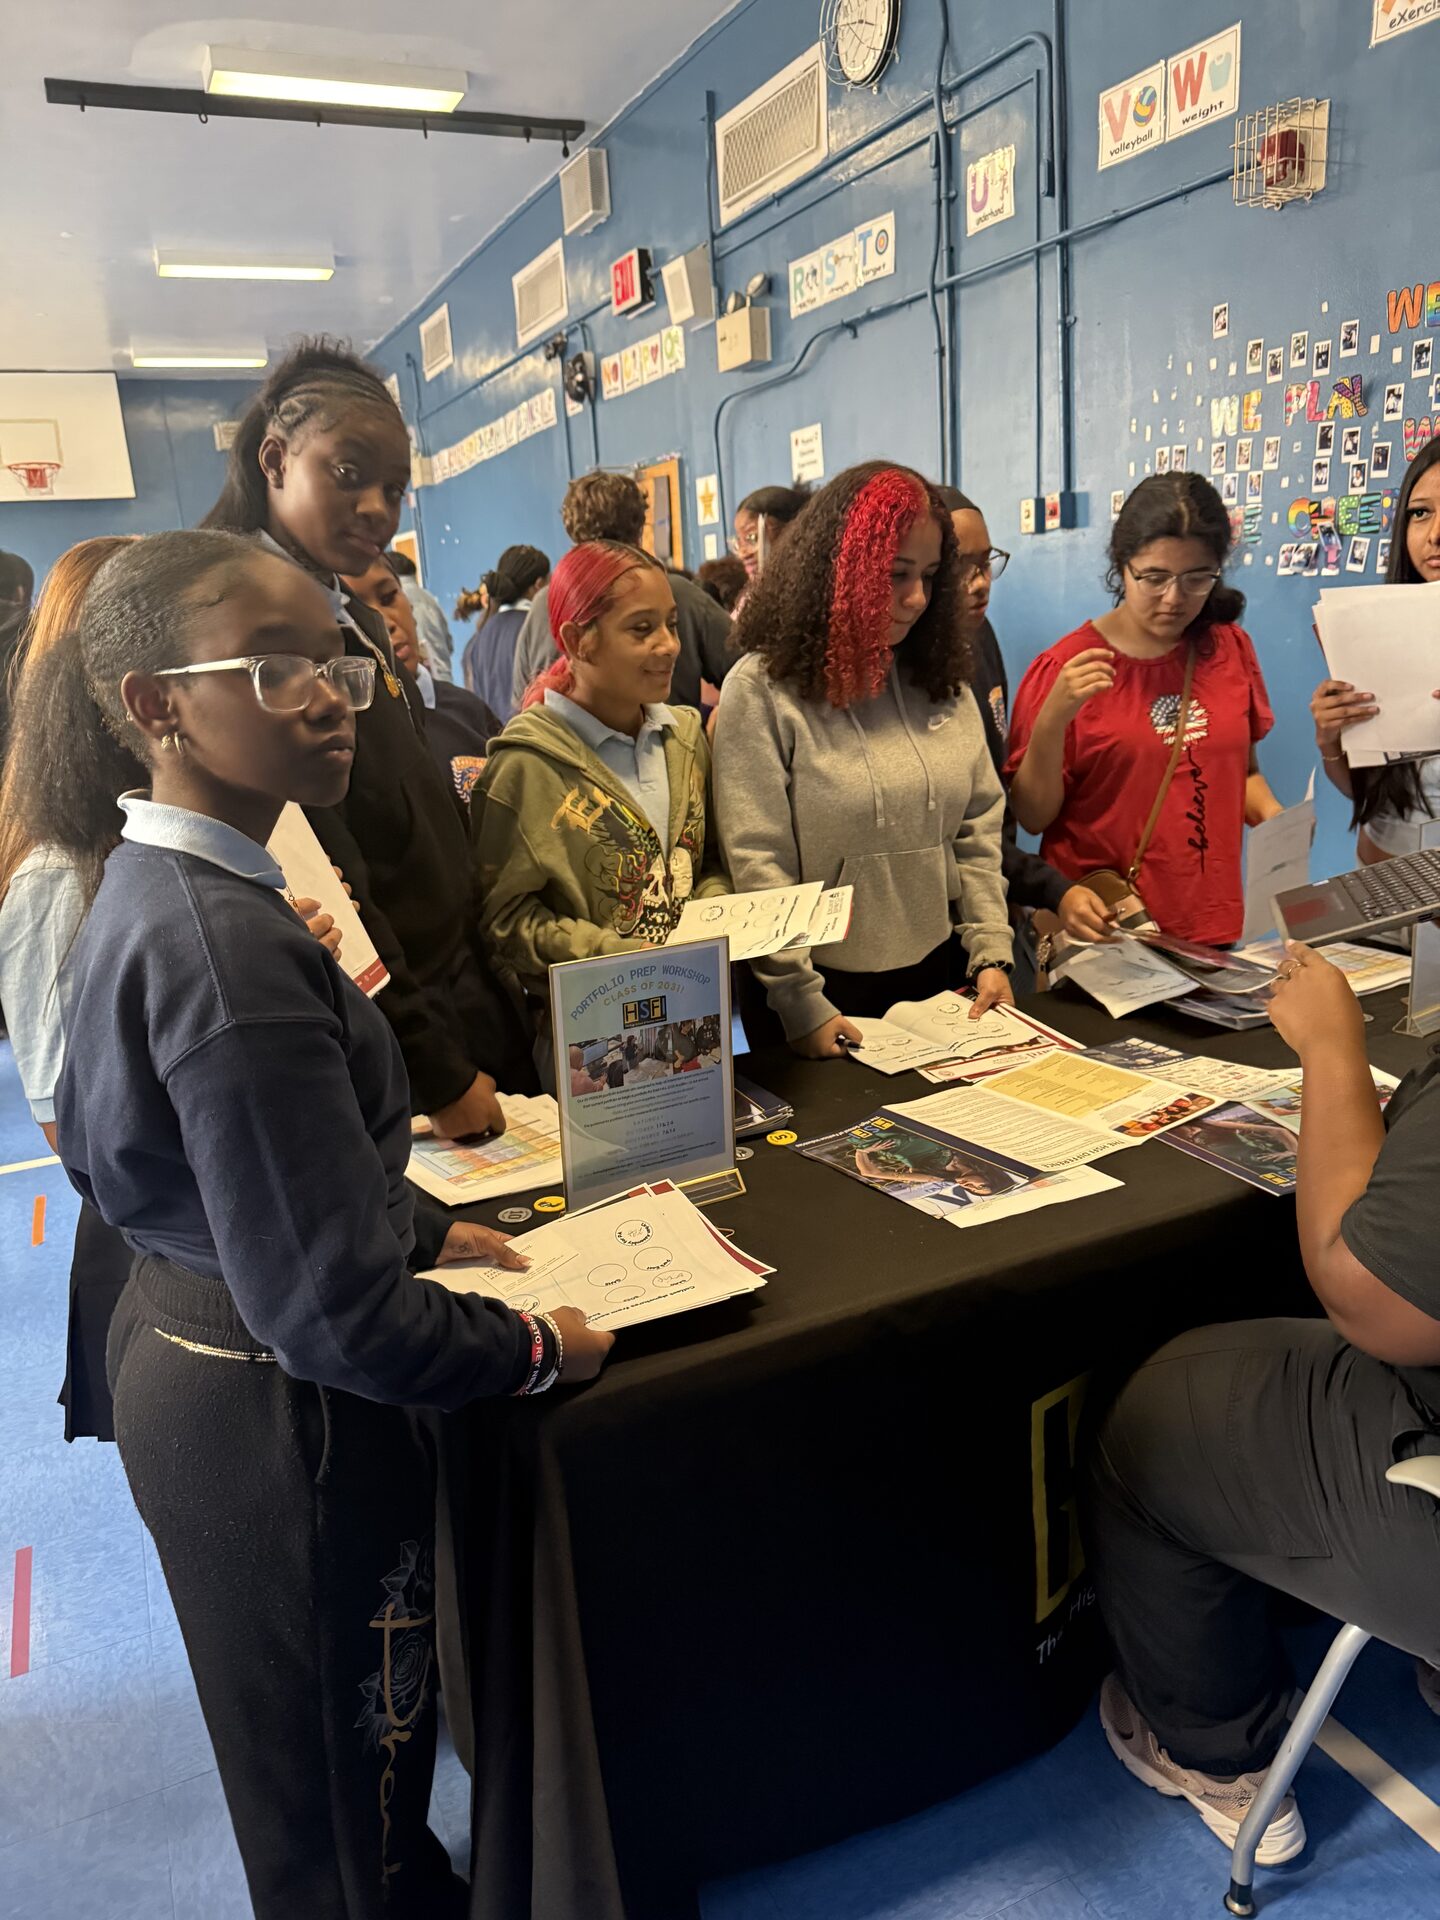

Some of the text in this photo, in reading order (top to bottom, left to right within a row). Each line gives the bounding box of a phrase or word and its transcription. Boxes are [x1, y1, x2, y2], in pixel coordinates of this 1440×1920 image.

[1173, 51, 1207, 112] W
[1103, 90, 1131, 142] V
[1181, 100, 1225, 125] weight
[1109, 129, 1153, 157] volleyball
[614, 254, 635, 307] EXIT
[1210, 374, 1368, 438] WE PLAY
[1186, 750, 1209, 872] believe
[570, 964, 711, 1021] PORTFOLIO PREP WORKSHOP
[603, 984, 637, 1006] CLASS
[640, 981, 655, 990] OF
[534, 1346, 542, 1368] REY
